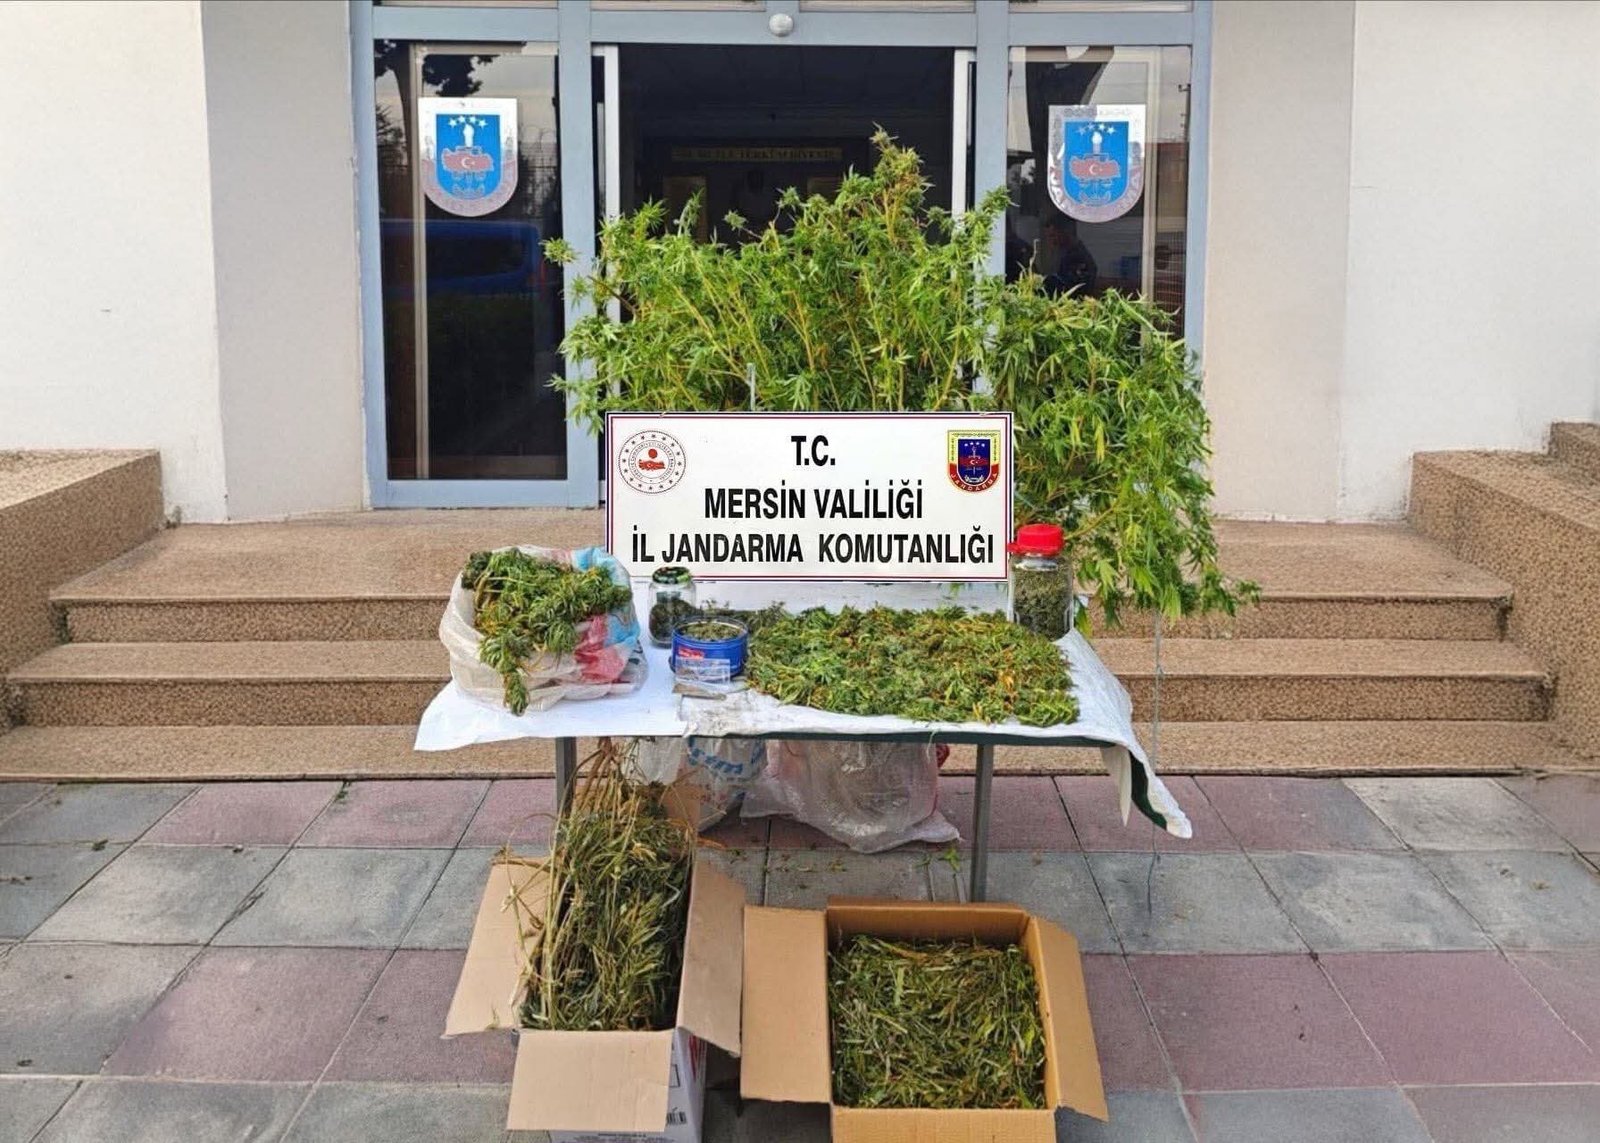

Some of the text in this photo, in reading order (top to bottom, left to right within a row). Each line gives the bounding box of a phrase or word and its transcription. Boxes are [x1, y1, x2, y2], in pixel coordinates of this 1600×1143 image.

[791, 435, 836, 467] T.C.
[705, 479, 923, 520] MERSİN VALİLİĞİ
[950, 473, 998, 491] JANDARMA
[632, 524, 994, 564] İL JANDARMA KOMUTANLIĞI
